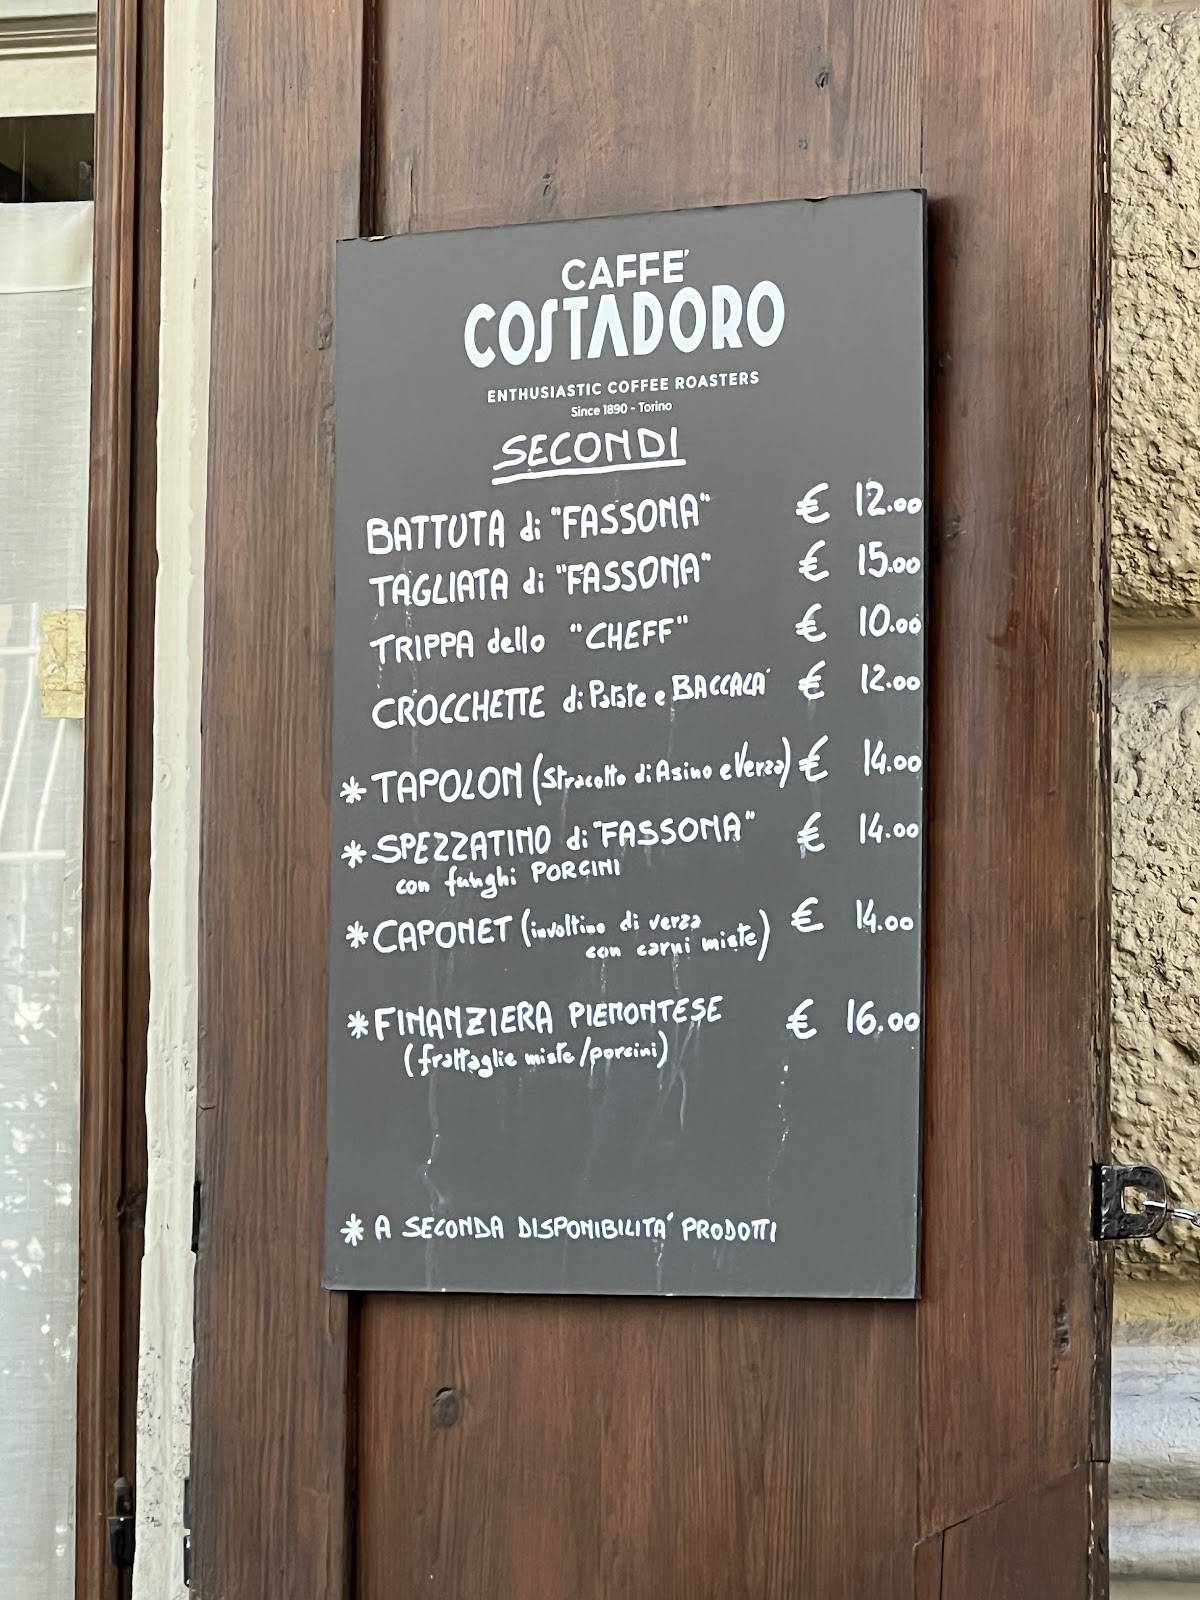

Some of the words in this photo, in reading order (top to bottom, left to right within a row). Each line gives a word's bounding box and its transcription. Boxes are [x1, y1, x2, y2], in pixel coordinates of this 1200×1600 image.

[463, 279, 786, 369] COSTADORO
[487, 382, 602, 403] ENTHUSIASTIC
[607, 377, 669, 395] COFFEE
[674, 370, 760, 390] ROASTERS
[570, 405, 601, 418] Since
[602, 402, 628, 416] 1890
[637, 400, 673, 413] Torino
[492, 426, 679, 471] SECONDI
[366, 508, 505, 555] BATTUTA
[519, 512, 542, 542] di
[795, 482, 831, 525] €
[855, 479, 923, 517] 12.00
[368, 567, 509, 608] TAGLIATA
[522, 566, 545, 595] di
[798, 539, 830, 583] €
[858, 540, 922, 578] 15.00
[369, 629, 474, 665] TRIPPA
[487, 624, 546, 655] dello
[794, 602, 828, 643] €
[859, 602, 922, 638] 10.00
[371, 684, 546, 730] CROCCHETTE
[562, 683, 584, 714] di
[588, 679, 647, 709] Patate
[654, 691, 666, 707] e
[797, 659, 826, 701] €
[860, 663, 921, 694] 12.00
[370, 761, 523, 804] TAPOLON
[634, 763, 652, 784] di
[655, 759, 713, 783] Asino
[719, 764, 733, 781] e
[798, 734, 829, 783] €
[863, 738, 922, 777] 14.00
[370, 824, 552, 865] SPEZZATINO
[565, 825, 589, 851] di
[796, 811, 826, 852] €
[859, 811, 920, 845] 14.00
[395, 878, 431, 895] con
[444, 865, 517, 900] funghi
[530, 858, 621, 884] PORCINI
[372, 914, 513, 953] CAPONET
[619, 909, 640, 932] di
[648, 913, 702, 931] verza
[790, 896, 825, 933] €
[855, 898, 914, 934] 14.00
[585, 945, 622, 960] con
[636, 936, 691, 956] carni
[374, 1000, 553, 1042] FINANZIERA
[567, 995, 724, 1029] PIEMONTESE
[785, 998, 818, 1040] €
[846, 998, 921, 1036] 16.00
[374, 1214, 392, 1241] A
[401, 1215, 505, 1240] SECONDA
[681, 1216, 777, 1243] PRODOTTI
